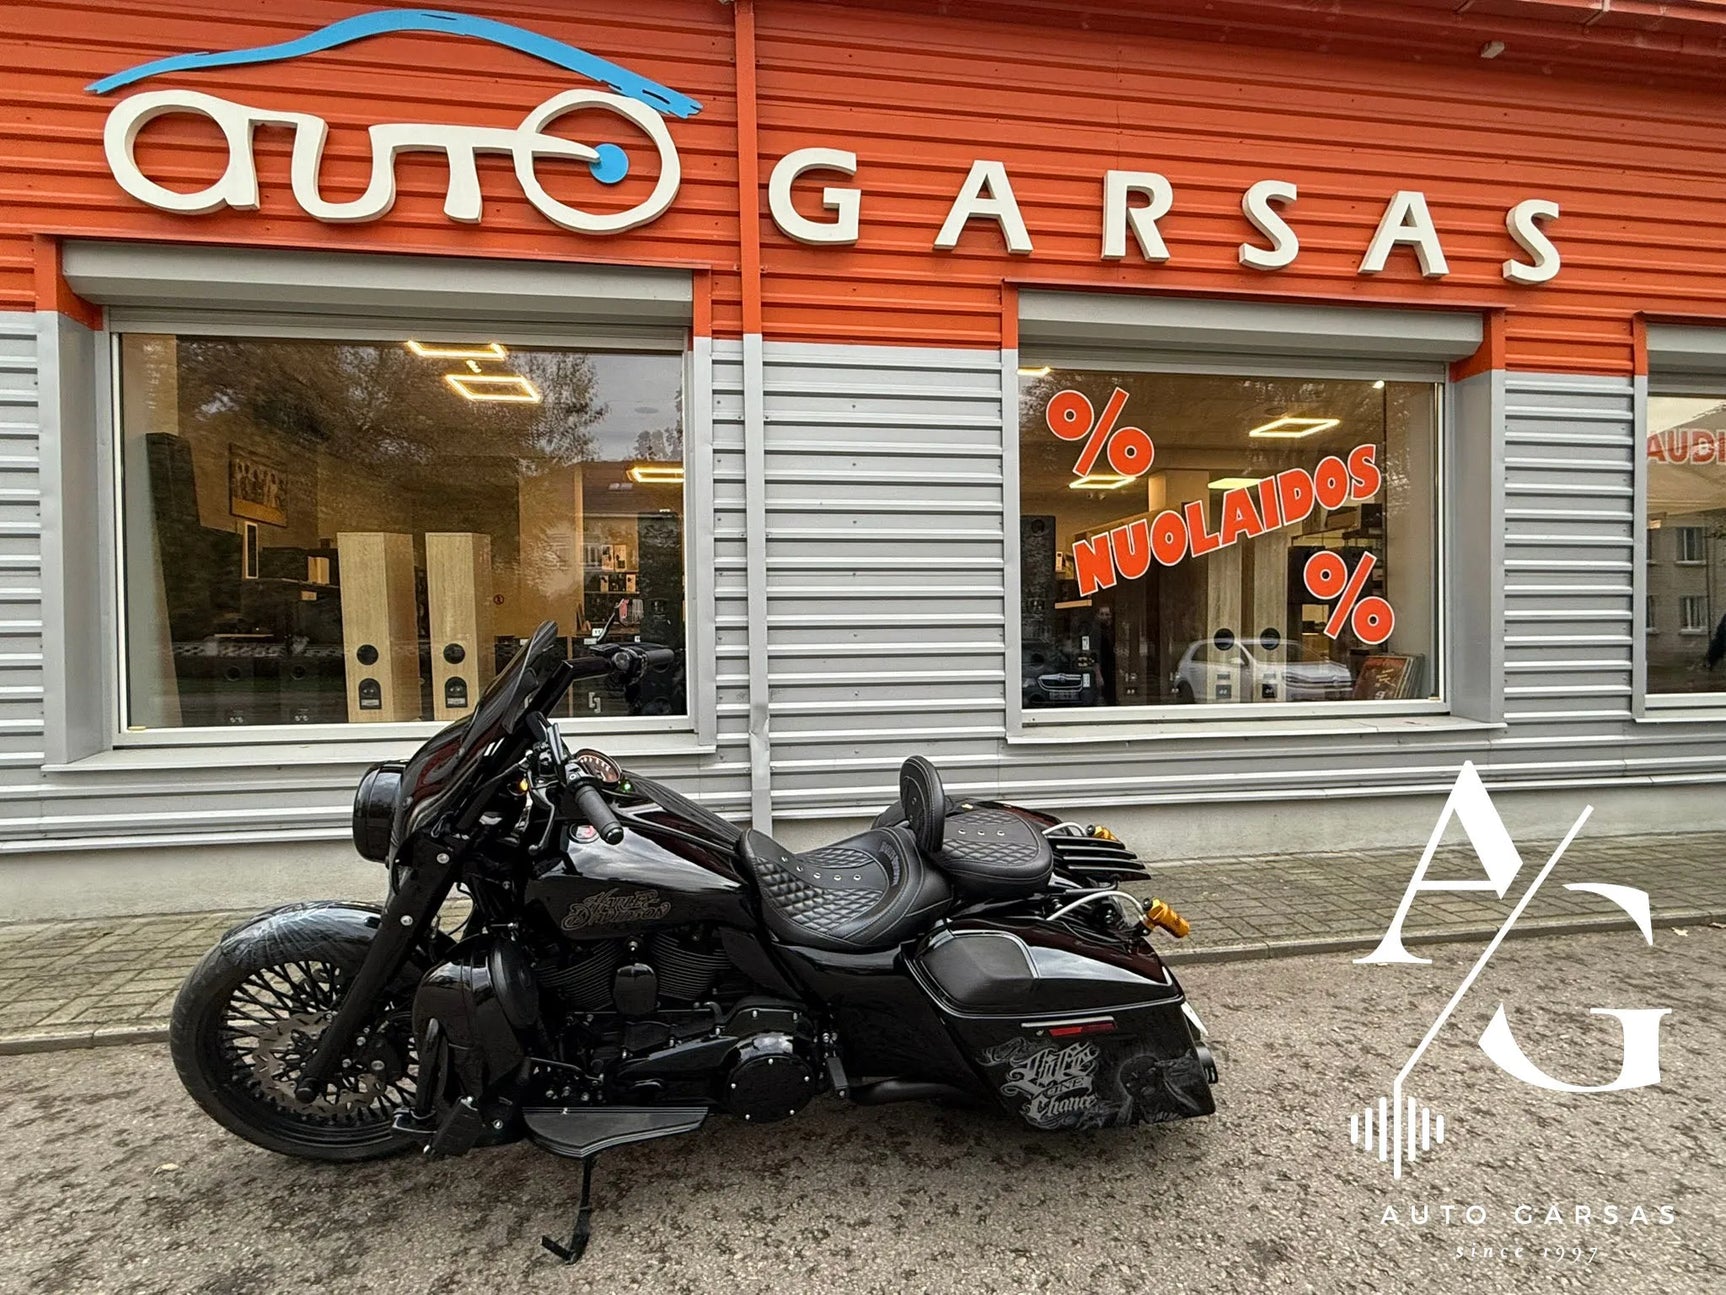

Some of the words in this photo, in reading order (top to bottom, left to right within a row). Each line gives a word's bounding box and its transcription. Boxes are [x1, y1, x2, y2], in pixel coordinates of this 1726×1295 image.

[768, 147, 1562, 285] GARSAS
[1046, 387, 1155, 478] %
[1072, 444, 1382, 598] NUOLAIDOS
[1303, 551, 1395, 645] %
